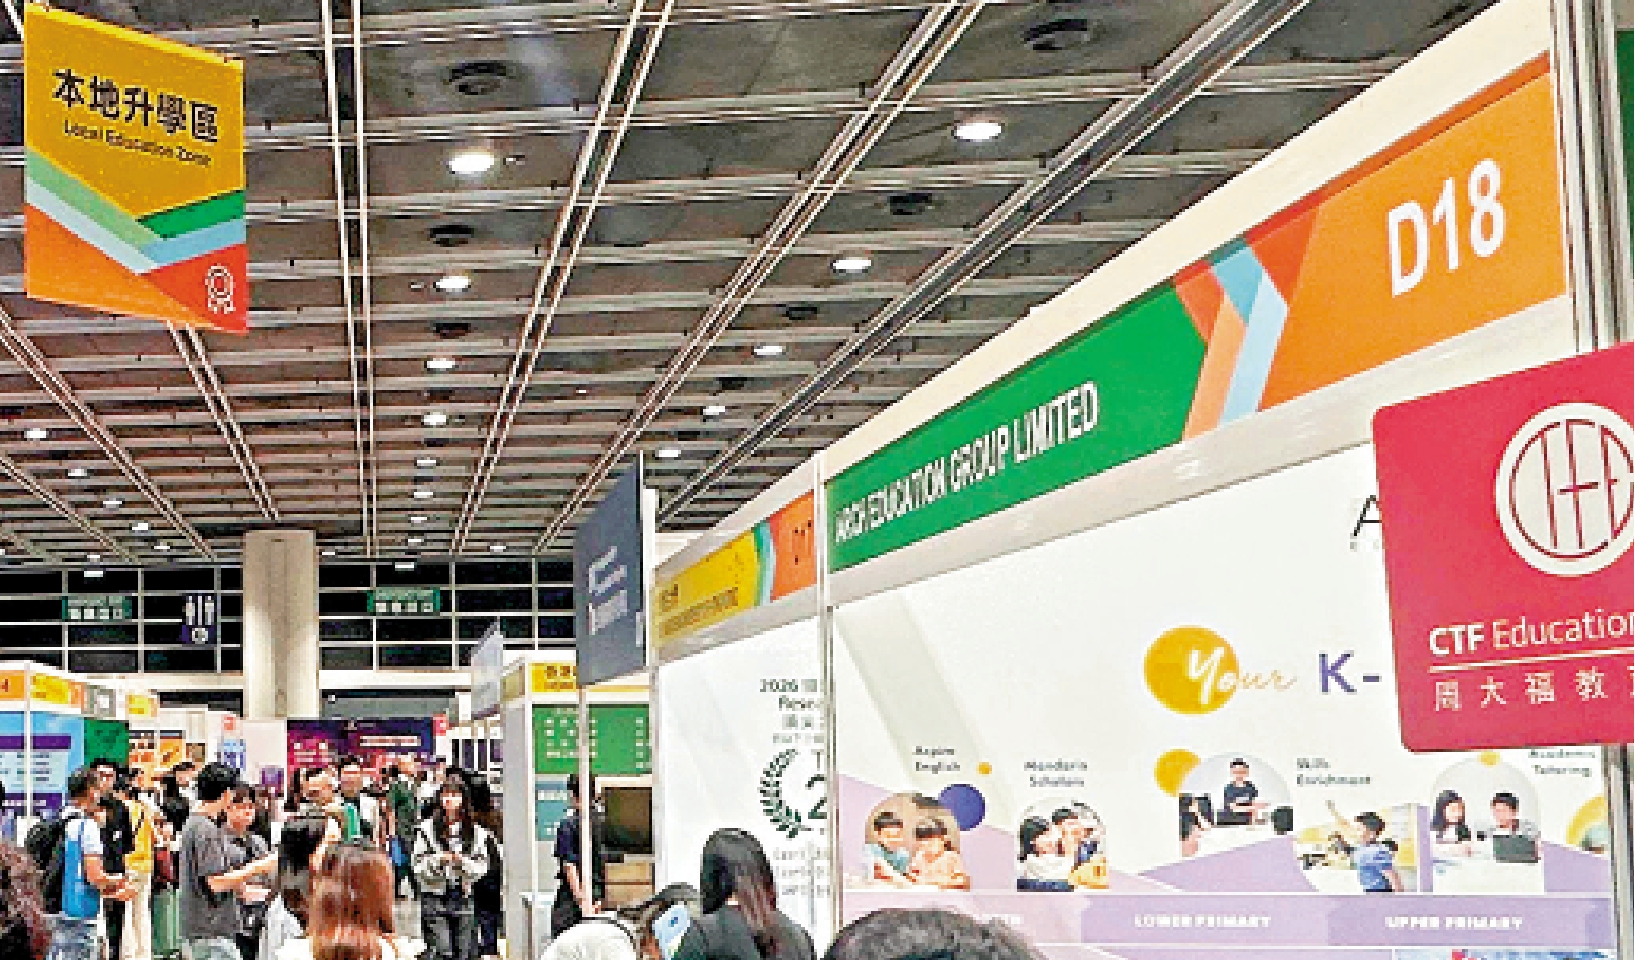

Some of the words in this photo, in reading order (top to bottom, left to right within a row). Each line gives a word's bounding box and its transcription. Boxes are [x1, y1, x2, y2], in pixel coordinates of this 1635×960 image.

[52, 68, 219, 143] 本地升學區
[64, 119, 103, 140] Local
[105, 129, 175, 157] Education
[176, 146, 212, 166] Zone
[1387, 158, 1506, 298] D18
[835, 498, 870, 544] ARCH
[869, 455, 947, 529] EDUCATION
[950, 424, 1010, 493] GROUP
[1013, 380, 1100, 464] LIMITED
[1429, 624, 1485, 657] CTF
[1492, 605, 1634, 650] Educatio
[759, 678, 799, 693] 2026
[1188, 646, 1297, 706] Your
[915, 761, 961, 774] English
[1134, 914, 1191, 928] LOWER
[1194, 914, 1272, 928] PRIMARY
[1385, 916, 1441, 930] UPPER
[1445, 916, 1524, 930] PRIMARY
